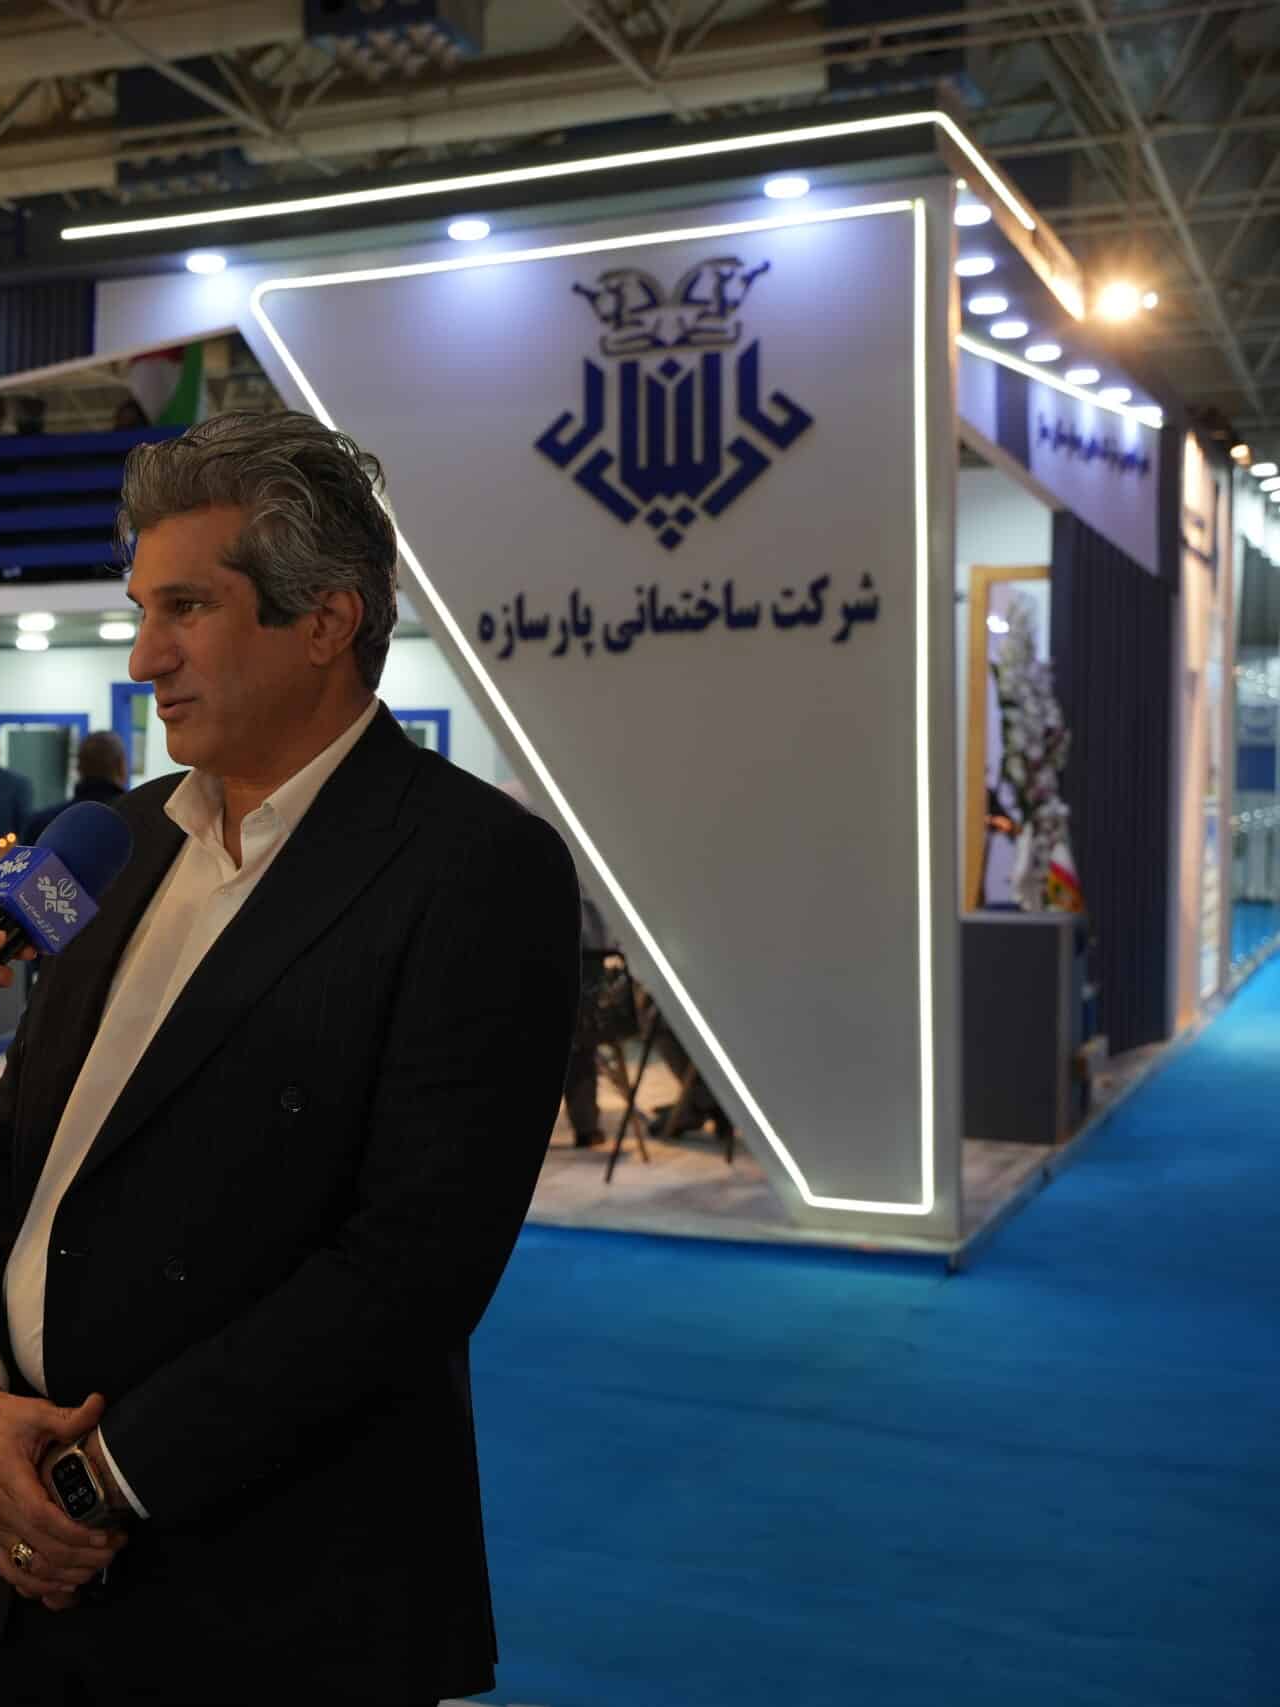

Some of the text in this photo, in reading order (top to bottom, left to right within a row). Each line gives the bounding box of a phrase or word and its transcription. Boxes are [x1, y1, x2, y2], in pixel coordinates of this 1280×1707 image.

[476, 572, 881, 661] شرکت ساختمانی پارسازه
